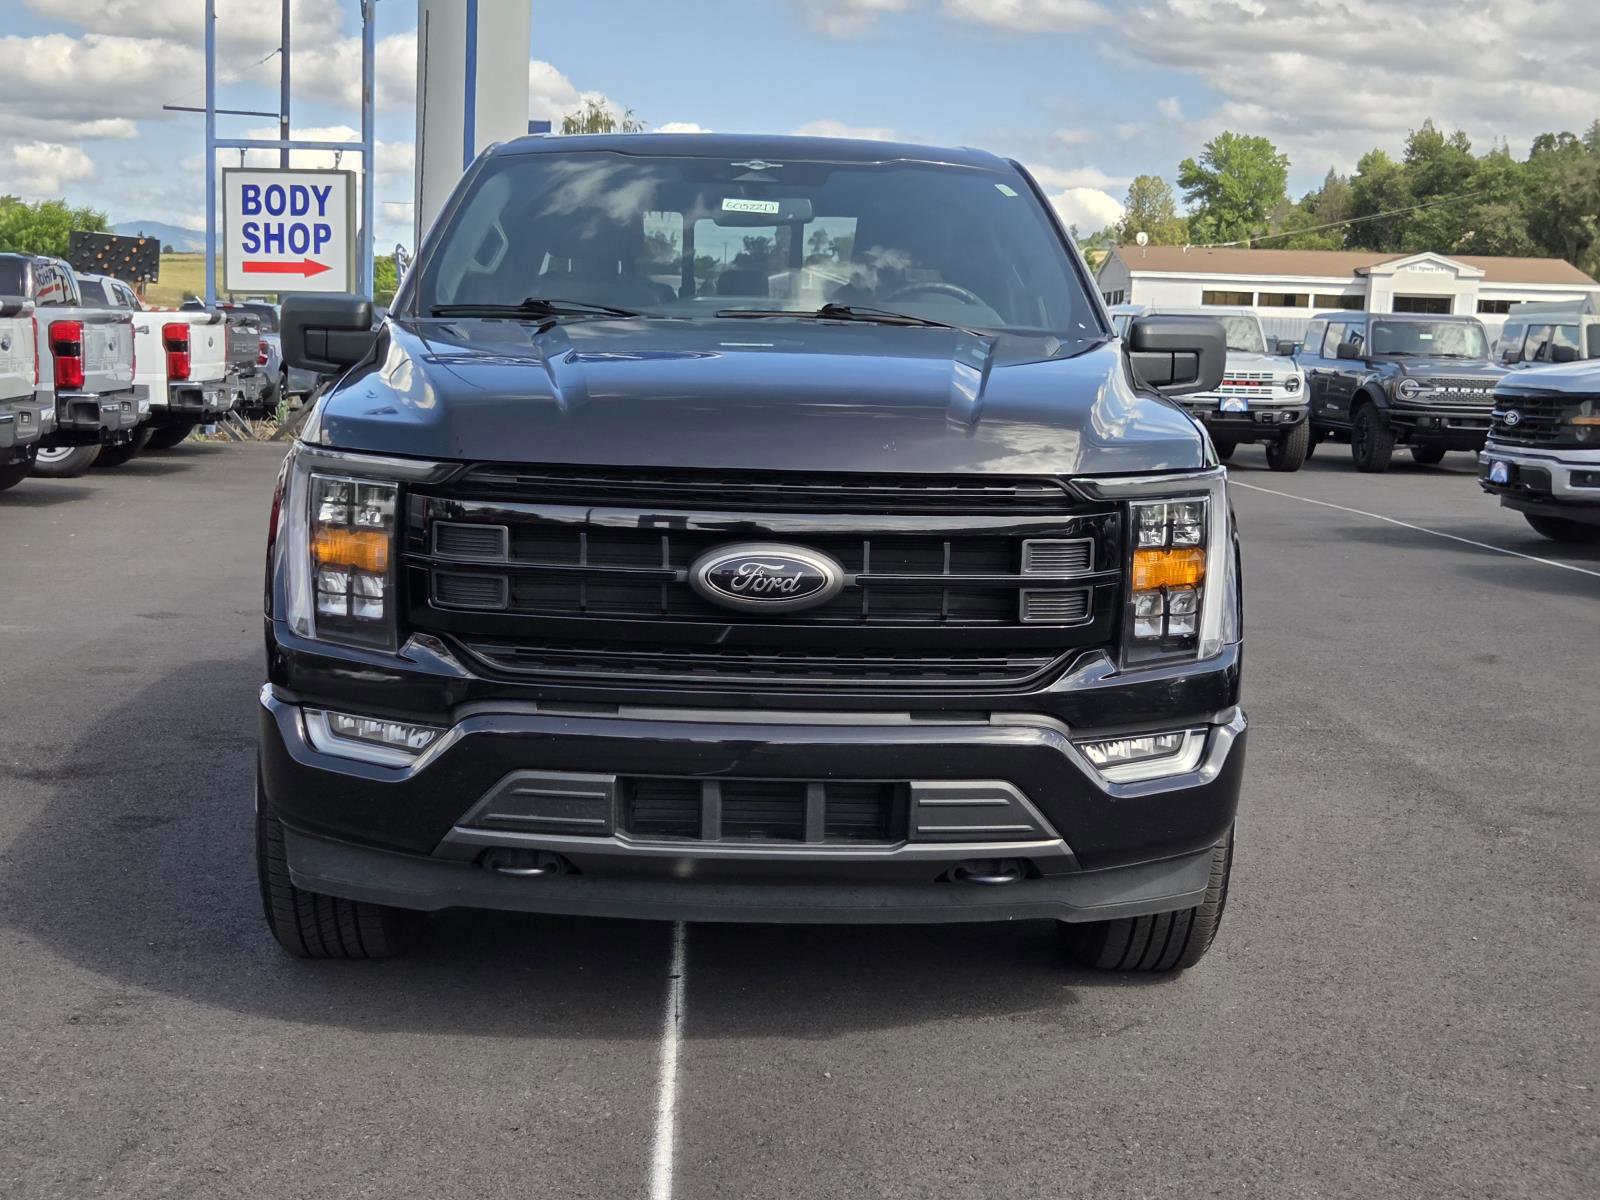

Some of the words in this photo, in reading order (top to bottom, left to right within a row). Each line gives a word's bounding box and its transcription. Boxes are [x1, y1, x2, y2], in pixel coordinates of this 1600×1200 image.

[241, 184, 333, 217] BODY
[241, 221, 332, 255] SHOP
[1435, 386, 1495, 394] BRONC
[730, 562, 803, 593] Ford
